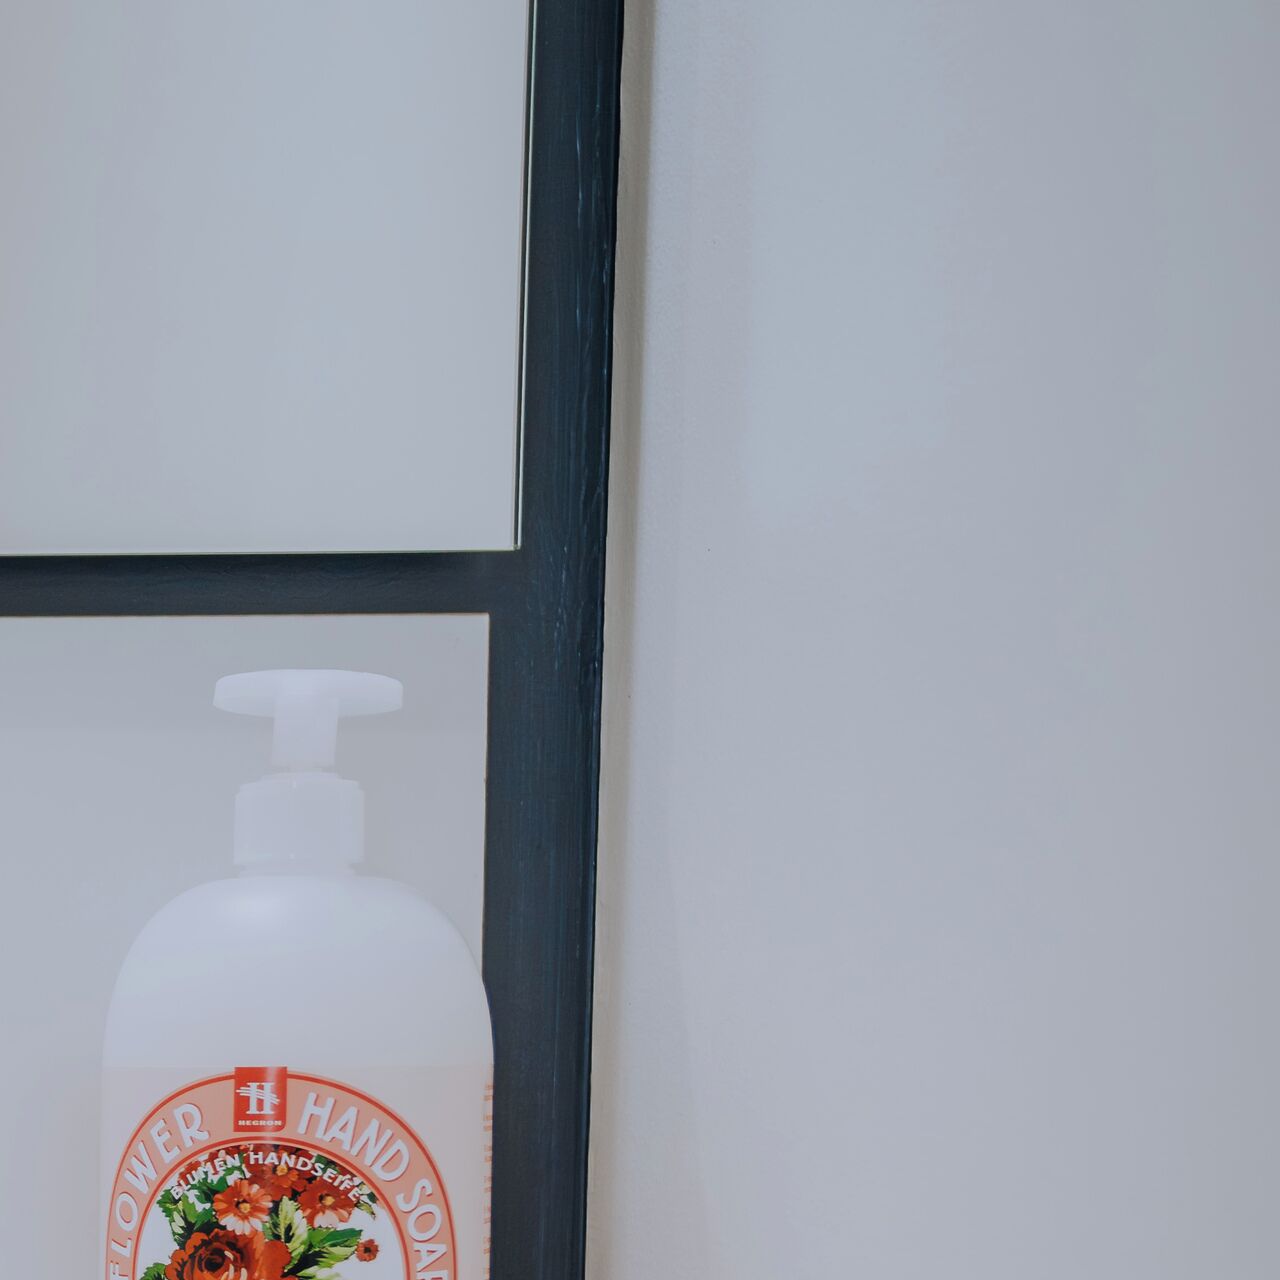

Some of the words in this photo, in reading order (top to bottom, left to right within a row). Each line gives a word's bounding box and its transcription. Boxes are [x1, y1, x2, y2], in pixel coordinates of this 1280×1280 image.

[237, 1119, 282, 1127] HEGRON
[297, 1092, 410, 1182] HAND
[169, 1153, 240, 1200] BLUMEN
[249, 1151, 361, 1202] HANDSEIFE
